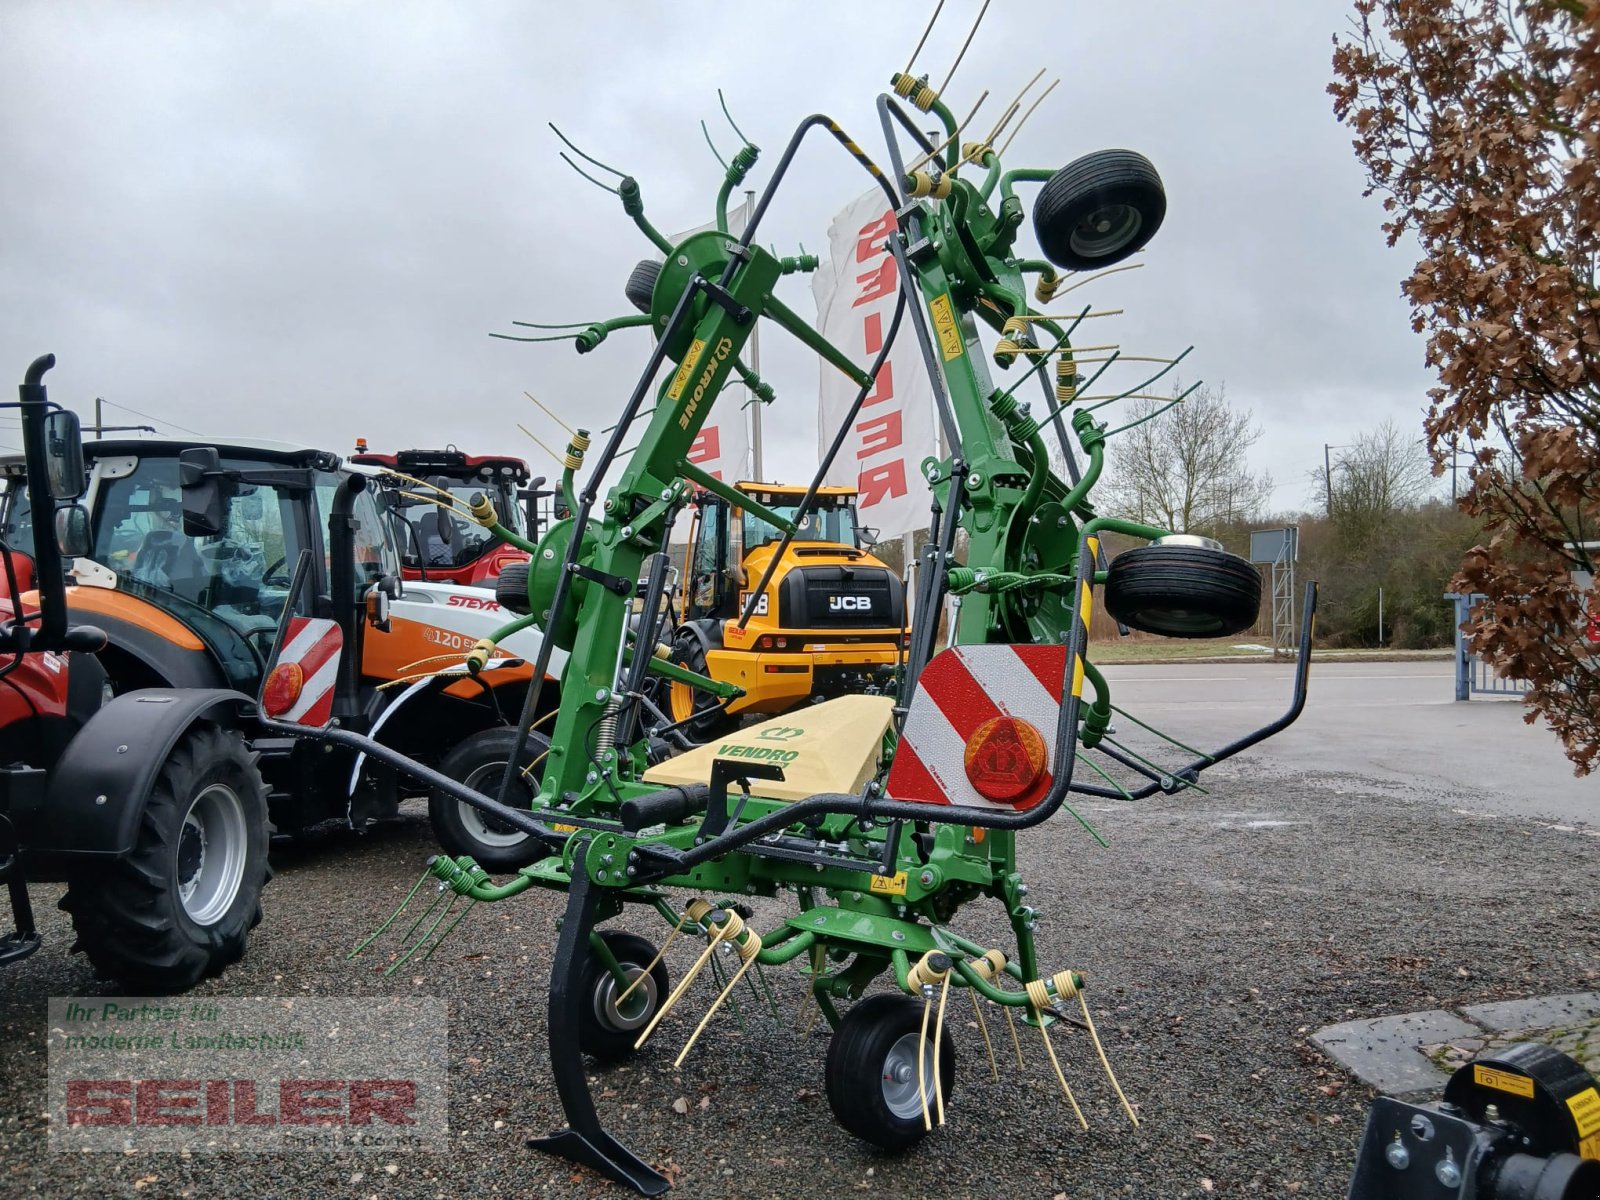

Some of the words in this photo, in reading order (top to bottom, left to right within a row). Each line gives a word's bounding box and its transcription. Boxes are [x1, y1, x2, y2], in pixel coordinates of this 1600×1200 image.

[679, 356, 719, 431] KRONE
[446, 595, 501, 612] STEYR
[829, 596, 872, 610] JCB
[423, 627, 462, 649] 4120
[717, 744, 799, 761] VENDRO
